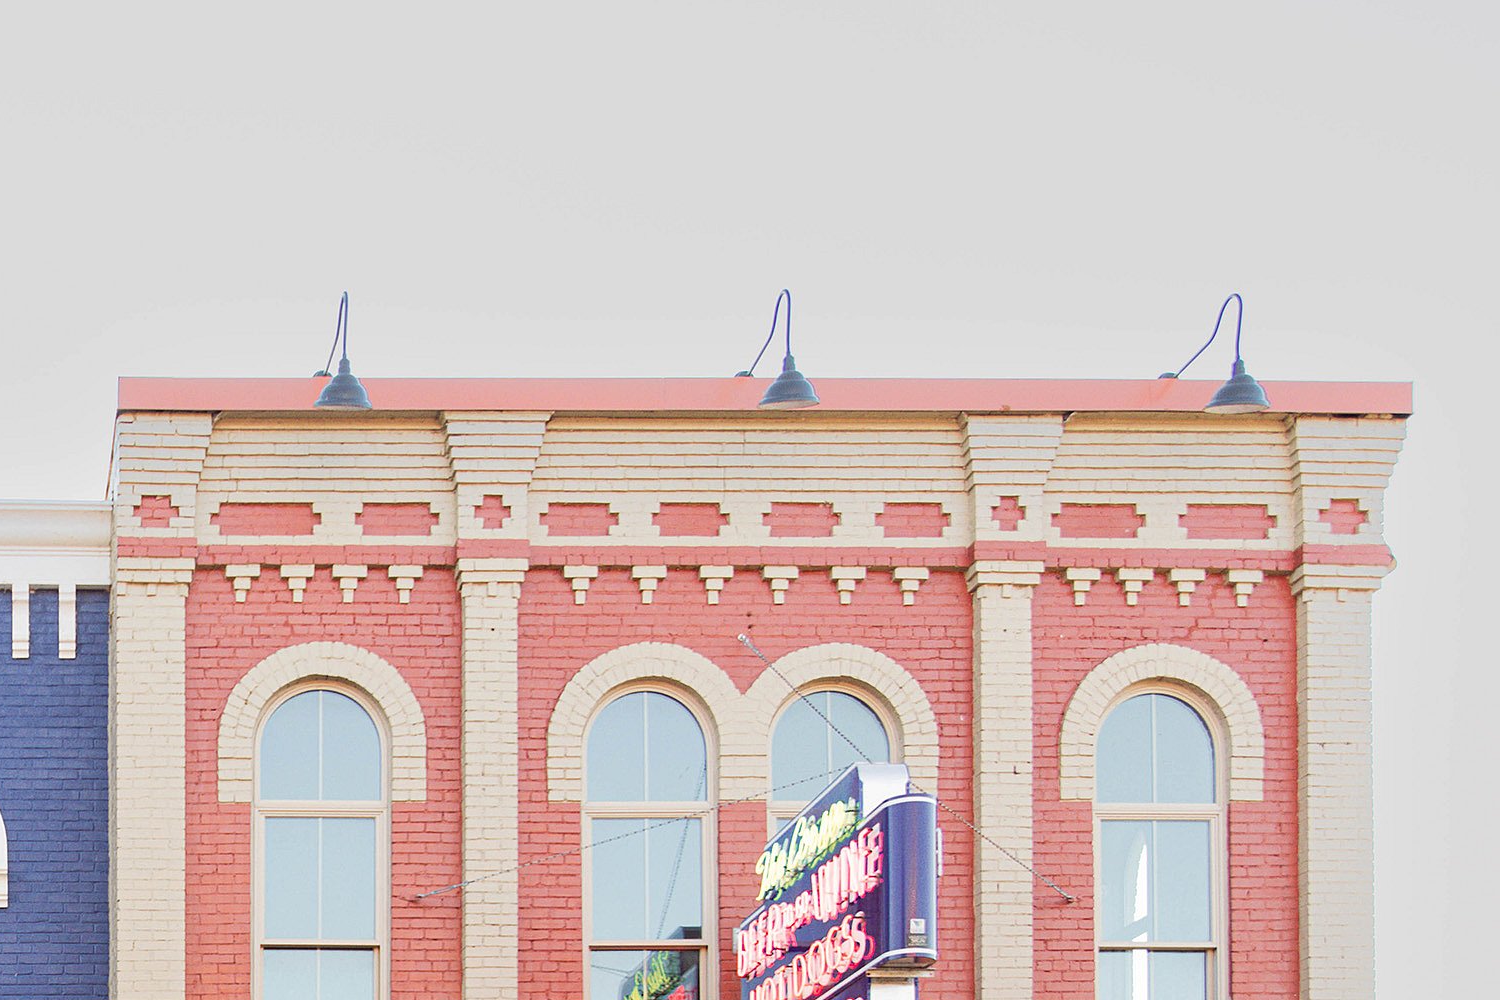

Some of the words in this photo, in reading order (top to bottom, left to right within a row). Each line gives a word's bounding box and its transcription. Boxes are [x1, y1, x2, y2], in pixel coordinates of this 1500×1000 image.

[737, 905, 789, 977] BEER
[811, 823, 884, 921] WINE
[792, 913, 870, 998] DOGS
